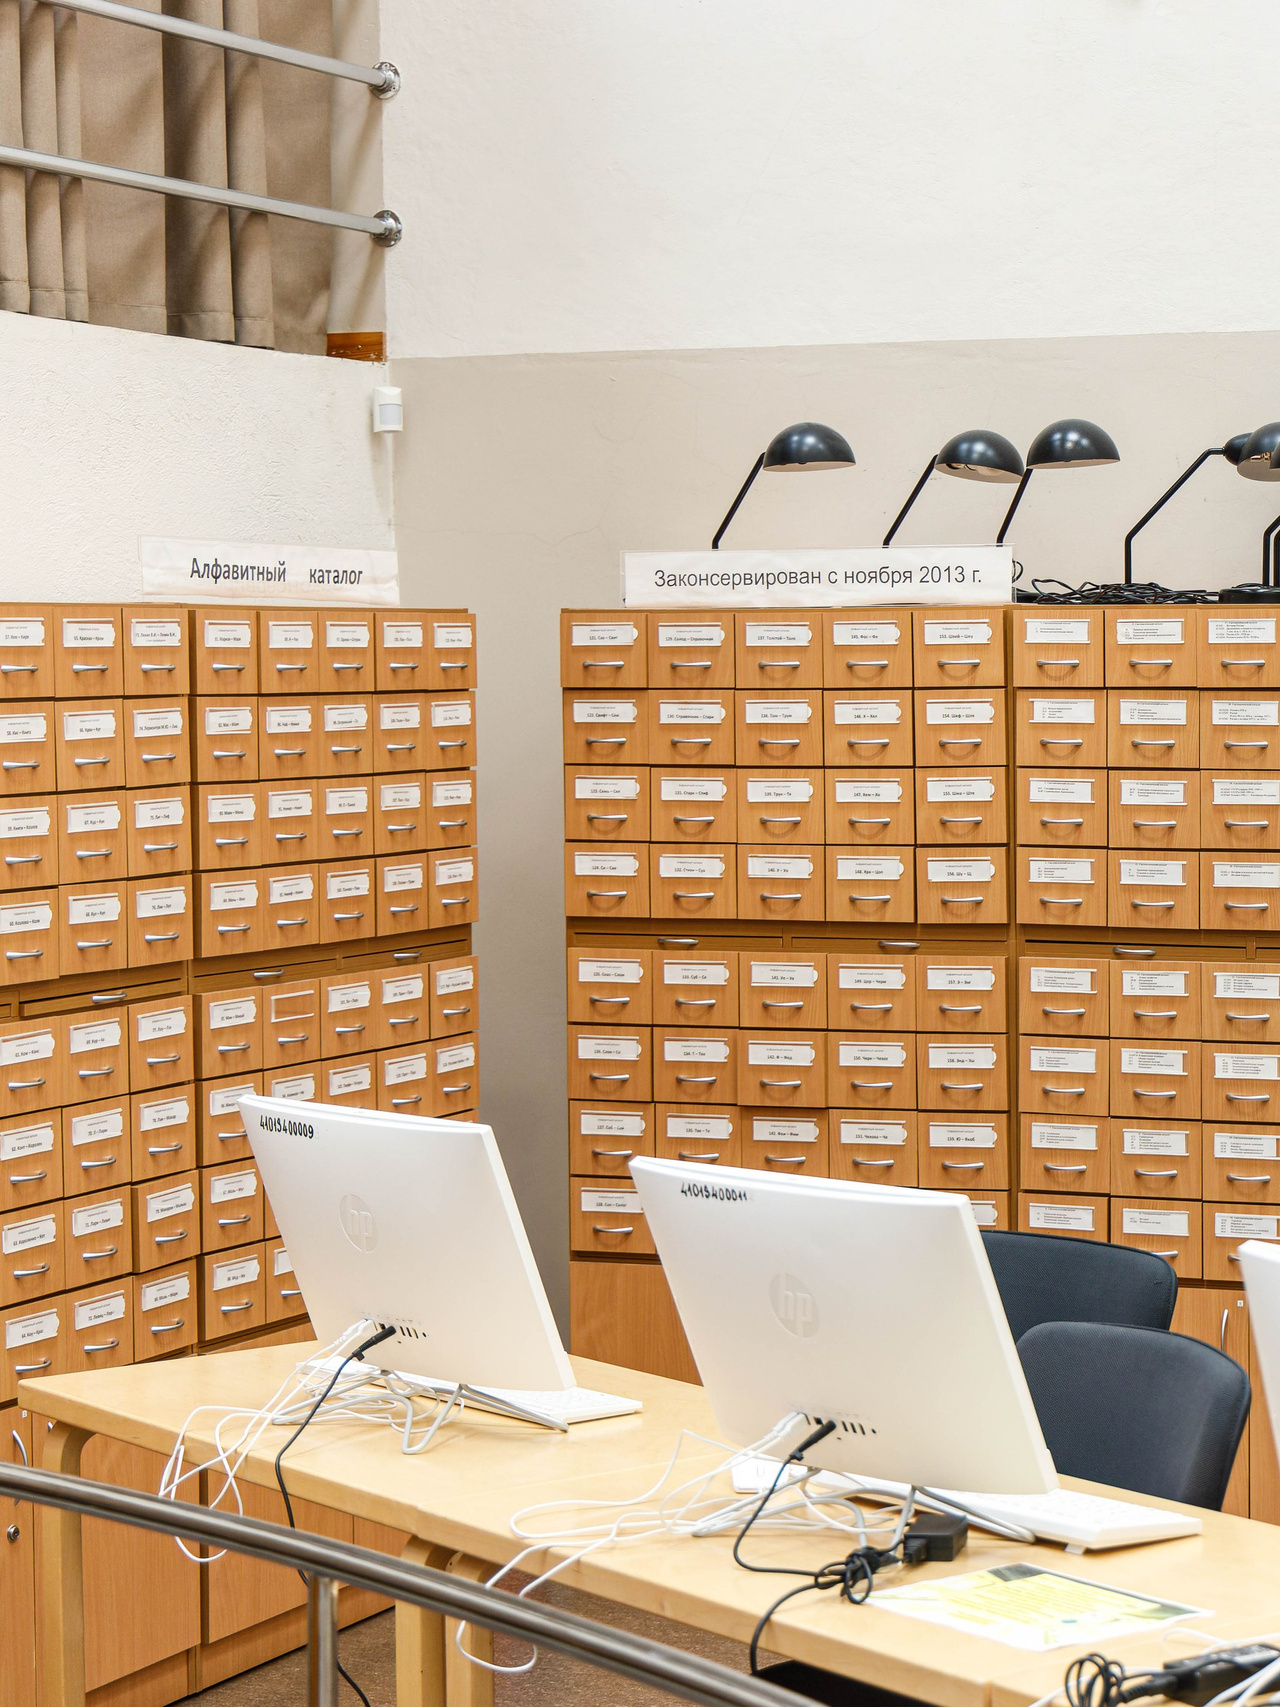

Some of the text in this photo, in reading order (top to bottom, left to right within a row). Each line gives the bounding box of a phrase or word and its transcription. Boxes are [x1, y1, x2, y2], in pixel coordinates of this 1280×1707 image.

[190, 558, 363, 584] Алфавитный каталог
[654, 566, 982, 589] Законсервирован с ноября 2013 г.
